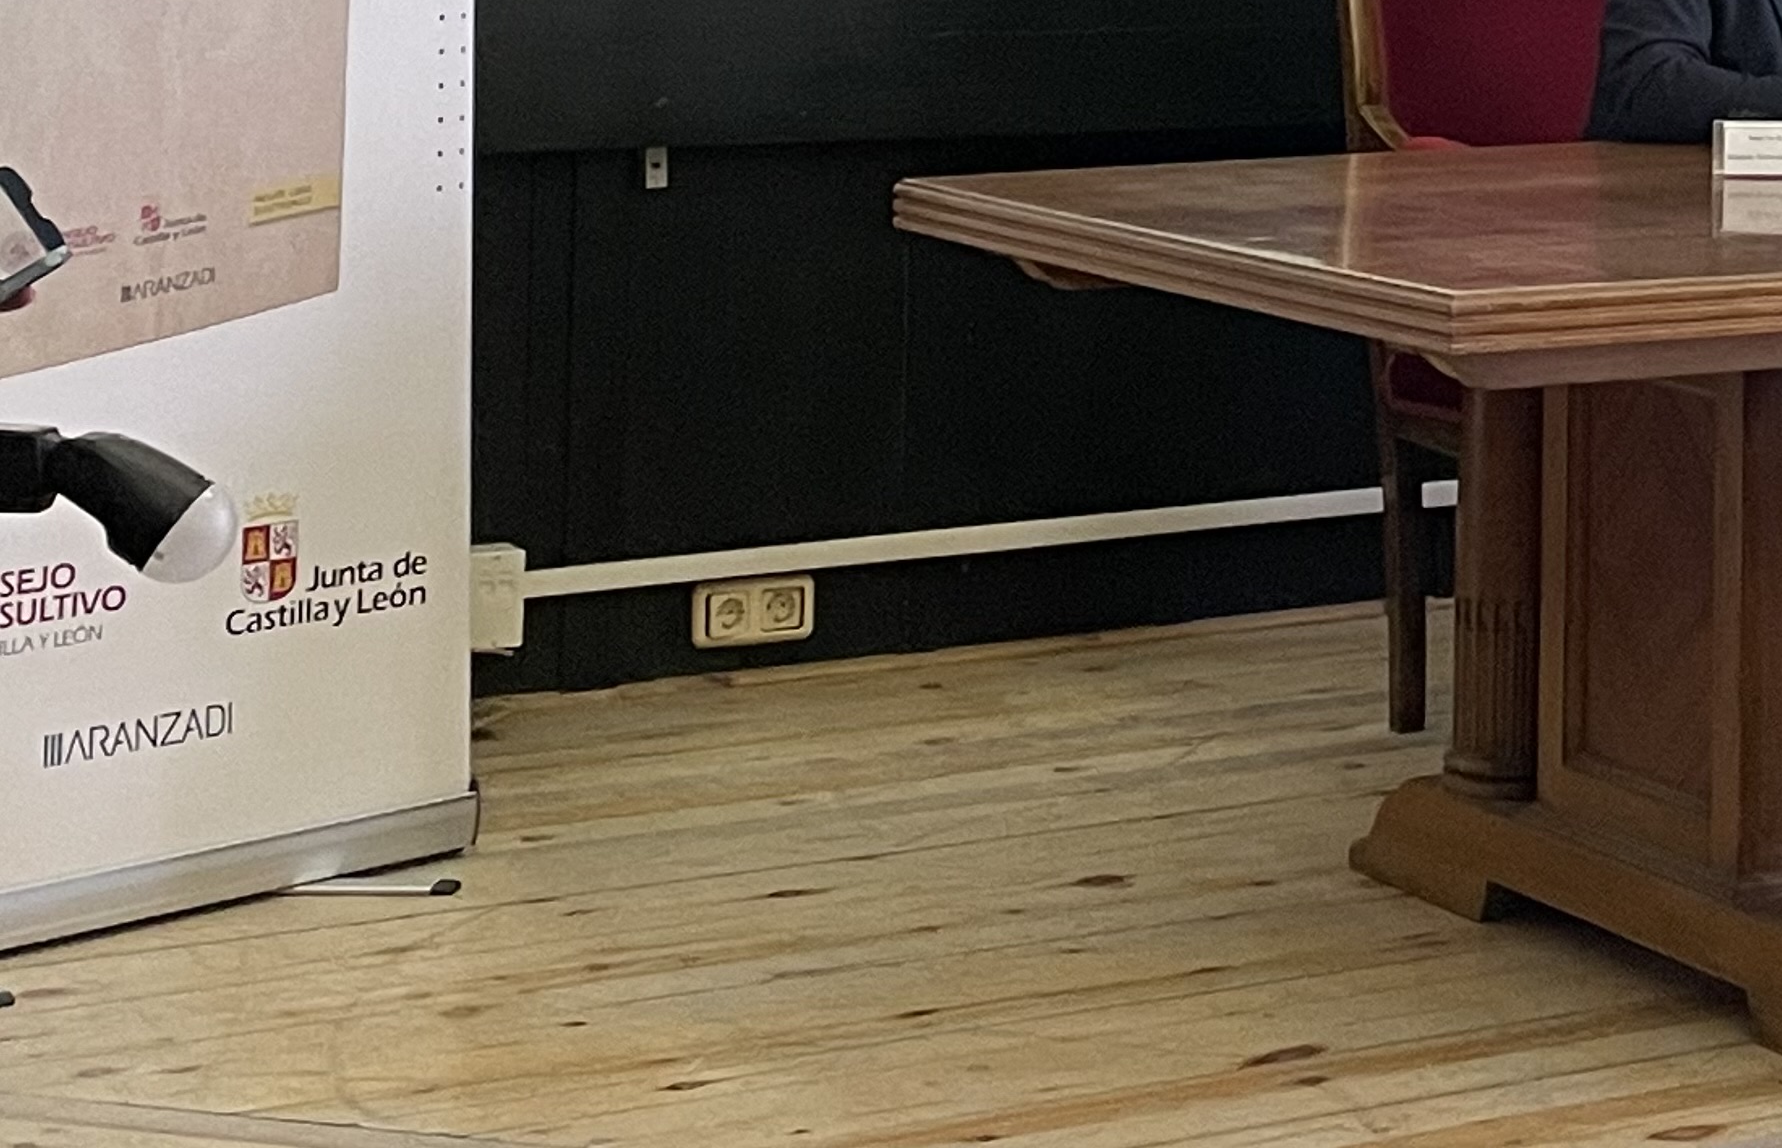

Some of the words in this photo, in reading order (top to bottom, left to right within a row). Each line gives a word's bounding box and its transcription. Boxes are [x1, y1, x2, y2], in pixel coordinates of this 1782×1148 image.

[0, 562, 76, 598] SEJO
[305, 558, 383, 594] Junta
[393, 551, 429, 581] de
[0, 585, 127, 629] SULTIVO
[356, 582, 429, 615] León
[64, 702, 234, 765] ARANZADI
